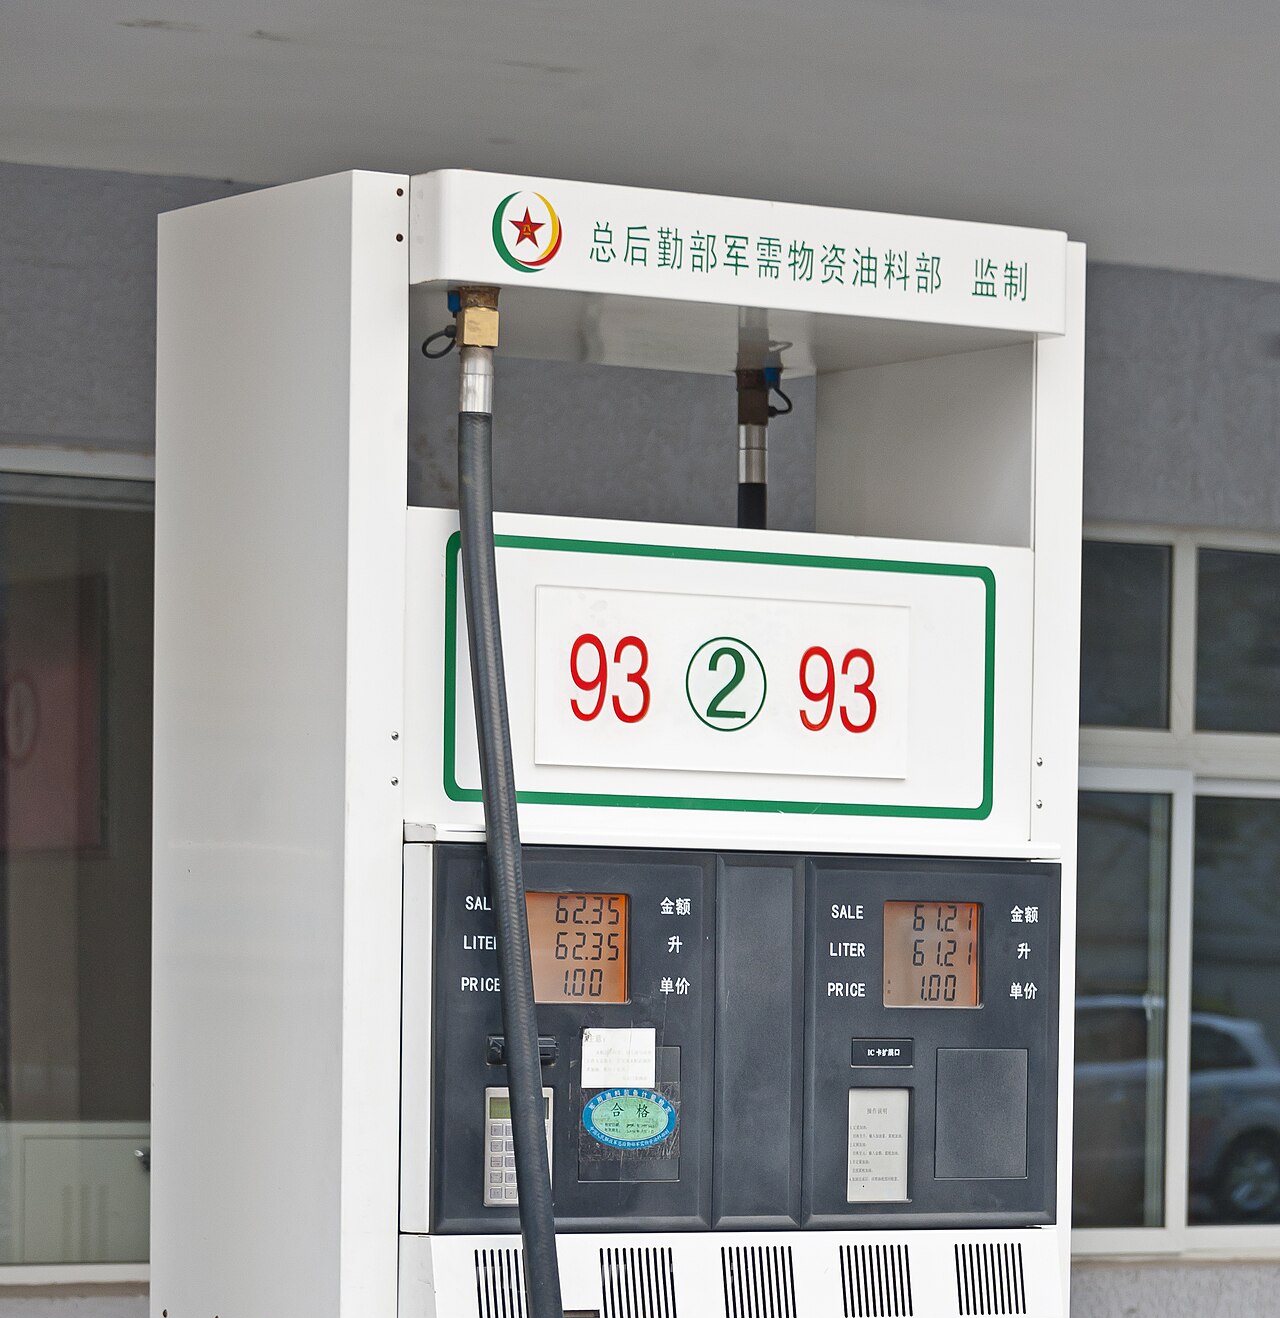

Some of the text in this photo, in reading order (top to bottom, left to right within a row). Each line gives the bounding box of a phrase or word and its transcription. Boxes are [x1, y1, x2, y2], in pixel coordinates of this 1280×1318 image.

[588, 220, 1030, 303] 总后勤部军需物资油料部 监制
[569, 632, 651, 724] 93
[798, 645, 878, 734] 93
[465, 895, 492, 911] SAL
[555, 896, 621, 925] 62.35
[660, 897, 692, 917] 金额
[831, 904, 865, 920] SALE
[912, 904, 973, 932] 61.21
[1010, 905, 1039, 924] 金额
[555, 931, 620, 961] 62.35
[667, 935, 683, 954] 升
[829, 942, 866, 958] LITER
[912, 939, 973, 967] 61.21
[1017, 942, 1031, 960] 升
[460, 976, 501, 992] PRICE
[563, 968, 604, 997] 1.00
[659, 976, 691, 996] 单价
[827, 982, 866, 998] PRICE
[920, 973, 957, 1002] 1.00
[1009, 982, 1038, 1001] 单价
[610, 1102, 651, 1118] 合格
